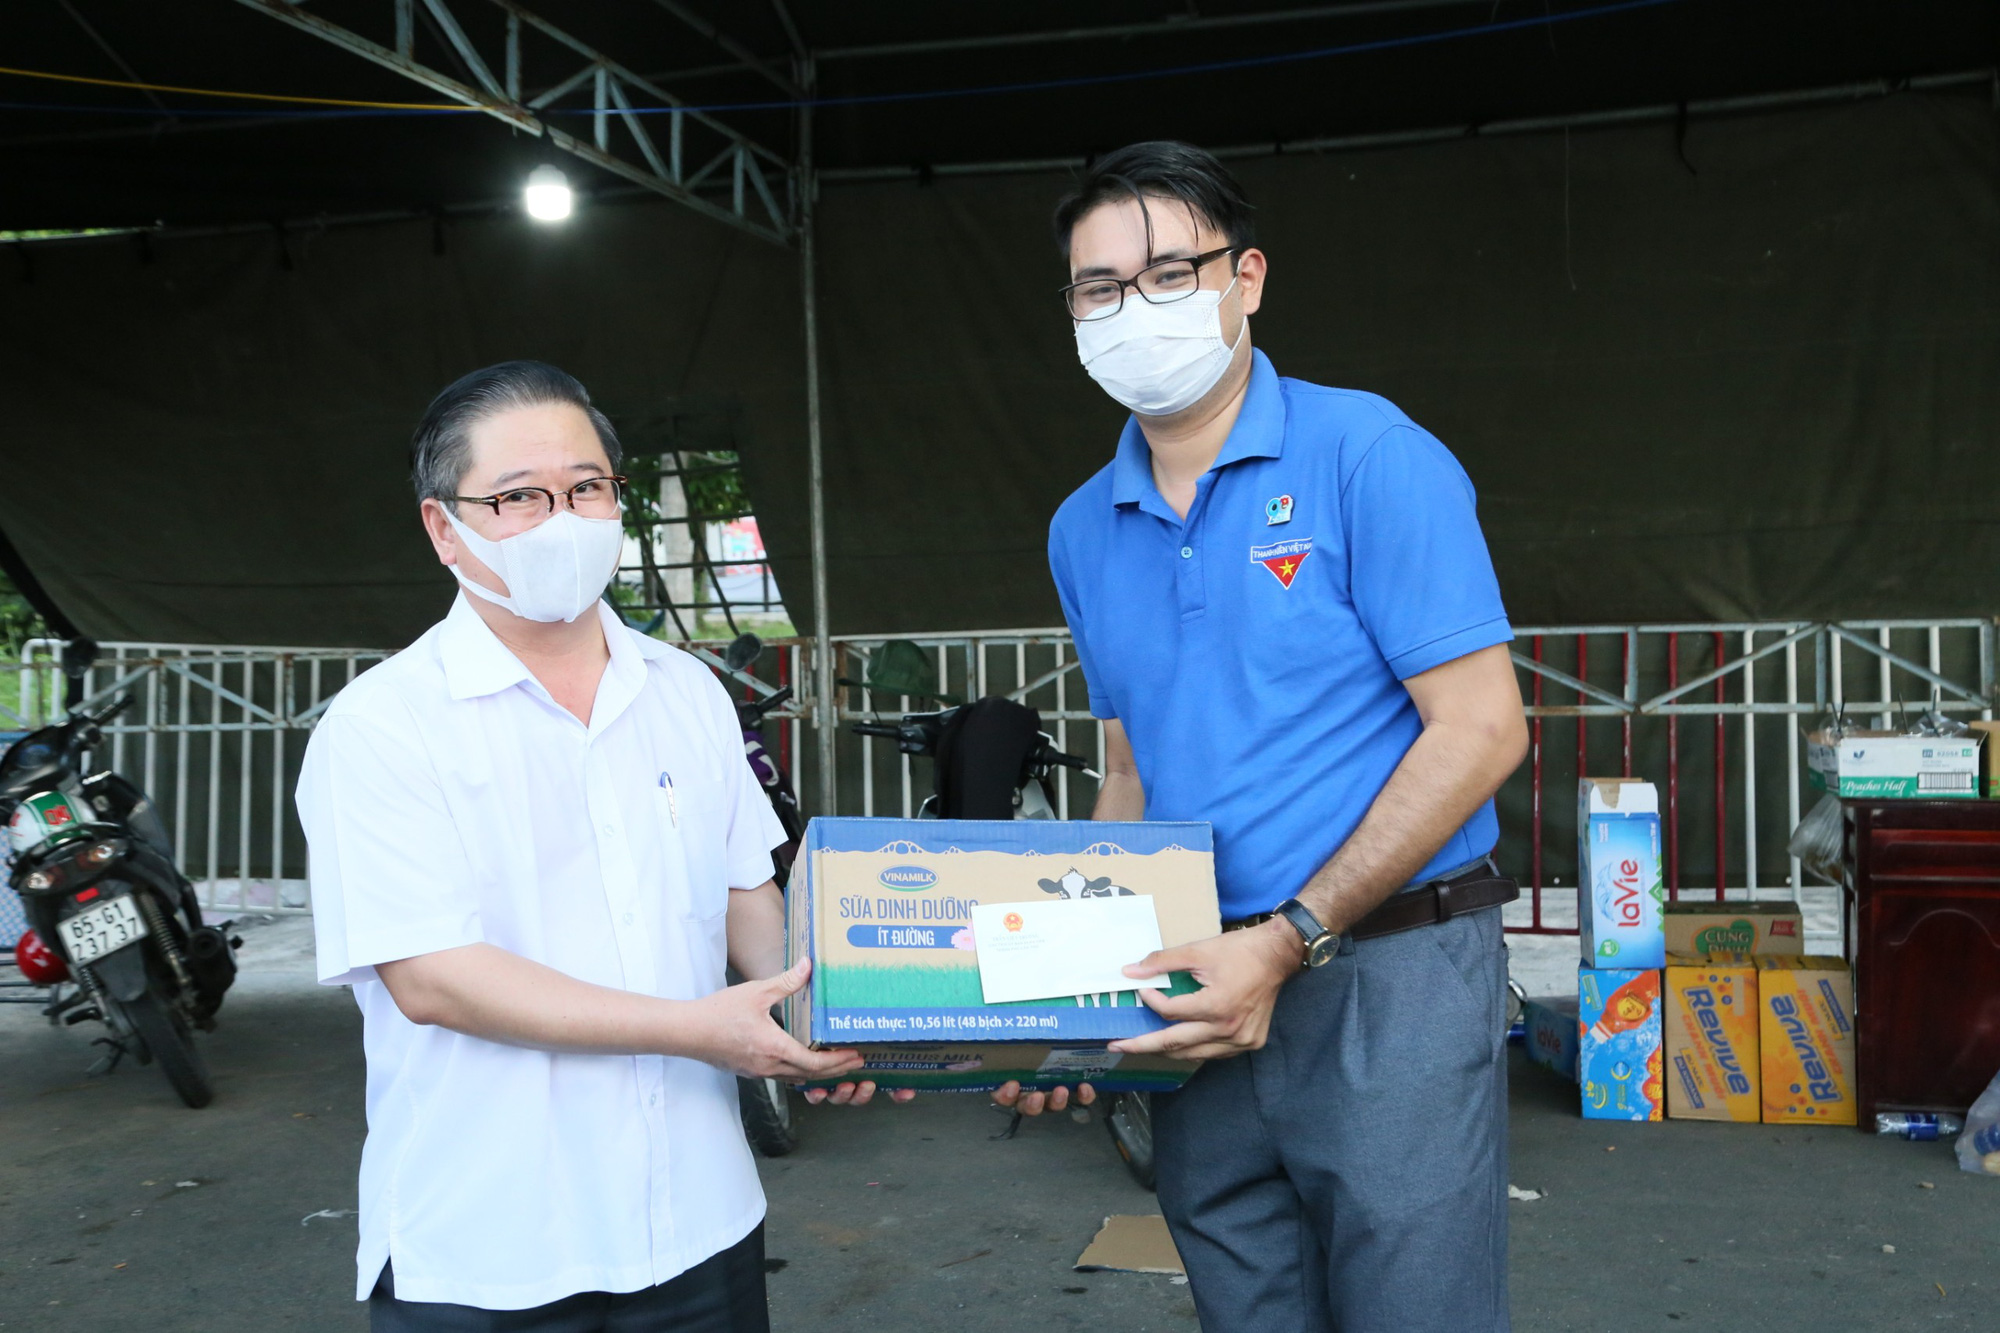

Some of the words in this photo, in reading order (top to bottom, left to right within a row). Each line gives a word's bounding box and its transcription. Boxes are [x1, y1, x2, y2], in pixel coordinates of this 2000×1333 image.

[1845, 780, 1881, 796] Peaches
[1883, 780, 1909, 795] Half
[883, 872, 934, 882] VINAMILK
[1613, 859, 1641, 927] laVie
[840, 894, 873, 919] SỮA
[877, 898, 917, 919] DINH
[878, 927, 889, 946] ÍT
[891, 926, 935, 946] ĐƯỜNG
[1705, 930, 1749, 943] CUNG
[829, 1015, 851, 1029] Thể
[853, 1016, 875, 1029] tích
[877, 1016, 907, 1032] thực:
[909, 1016, 941, 1030] 10,56
[942, 1015, 956, 1028] lít
[957, 1015, 976, 1029] (48
[978, 1015, 1002, 1031] bịch
[1016, 1015, 1037, 1028] 220
[1039, 1015, 1059, 1029] ml)
[1683, 985, 1752, 1096] Revive
[1770, 994, 1842, 1103] Revive
[863, 1053, 940, 1062] TRITIOUS
[944, 1053, 985, 1062] MILK
[864, 1062, 895, 1070] LESS
[899, 1062, 938, 1070] SUGAR
